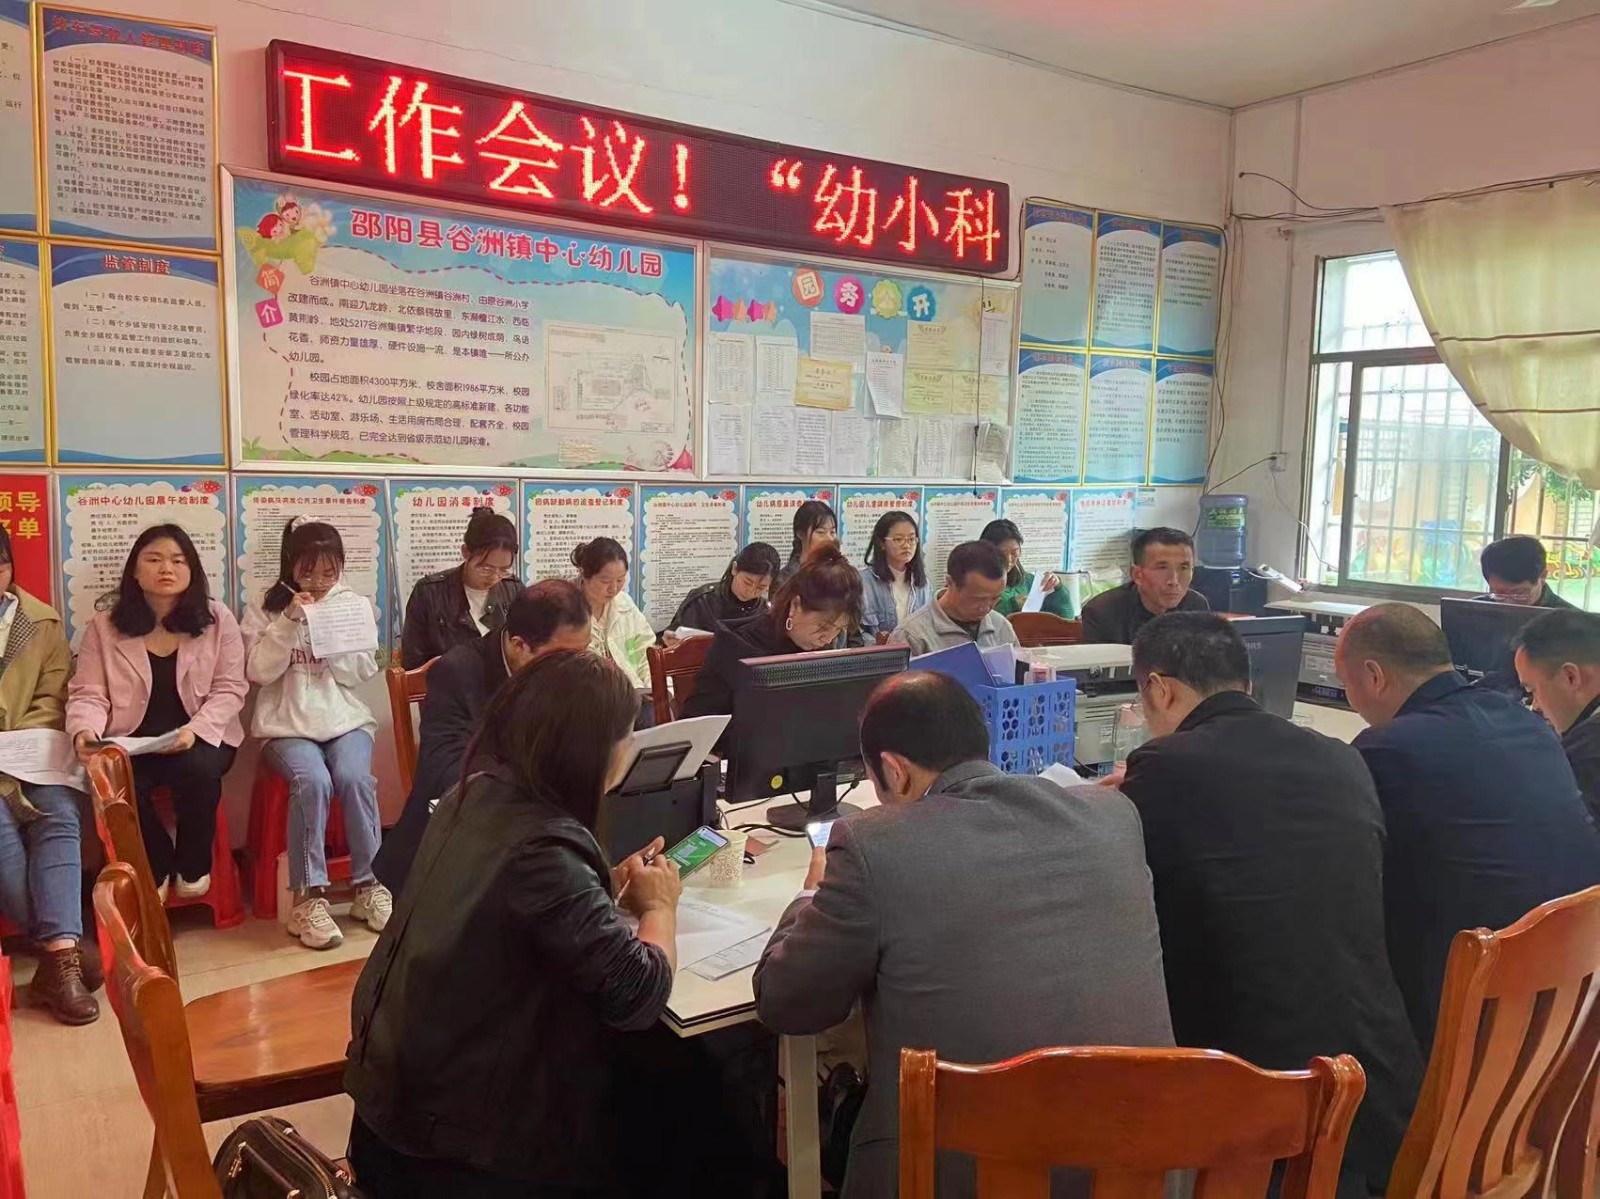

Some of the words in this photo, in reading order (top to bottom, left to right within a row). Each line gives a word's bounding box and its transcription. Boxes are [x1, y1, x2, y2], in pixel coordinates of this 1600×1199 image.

[282, 69, 692, 215] 工作会议！
[350, 208, 663, 278] 邵阳县谷洲镇中心幼儿园
[103, 254, 171, 275] 监管制度
[289, 352, 325, 364] 幼儿园。
[77, 495, 210, 506] 谷洲中心幼儿园晨午检制度
[412, 496, 495, 508] 幼儿园消毒制度
